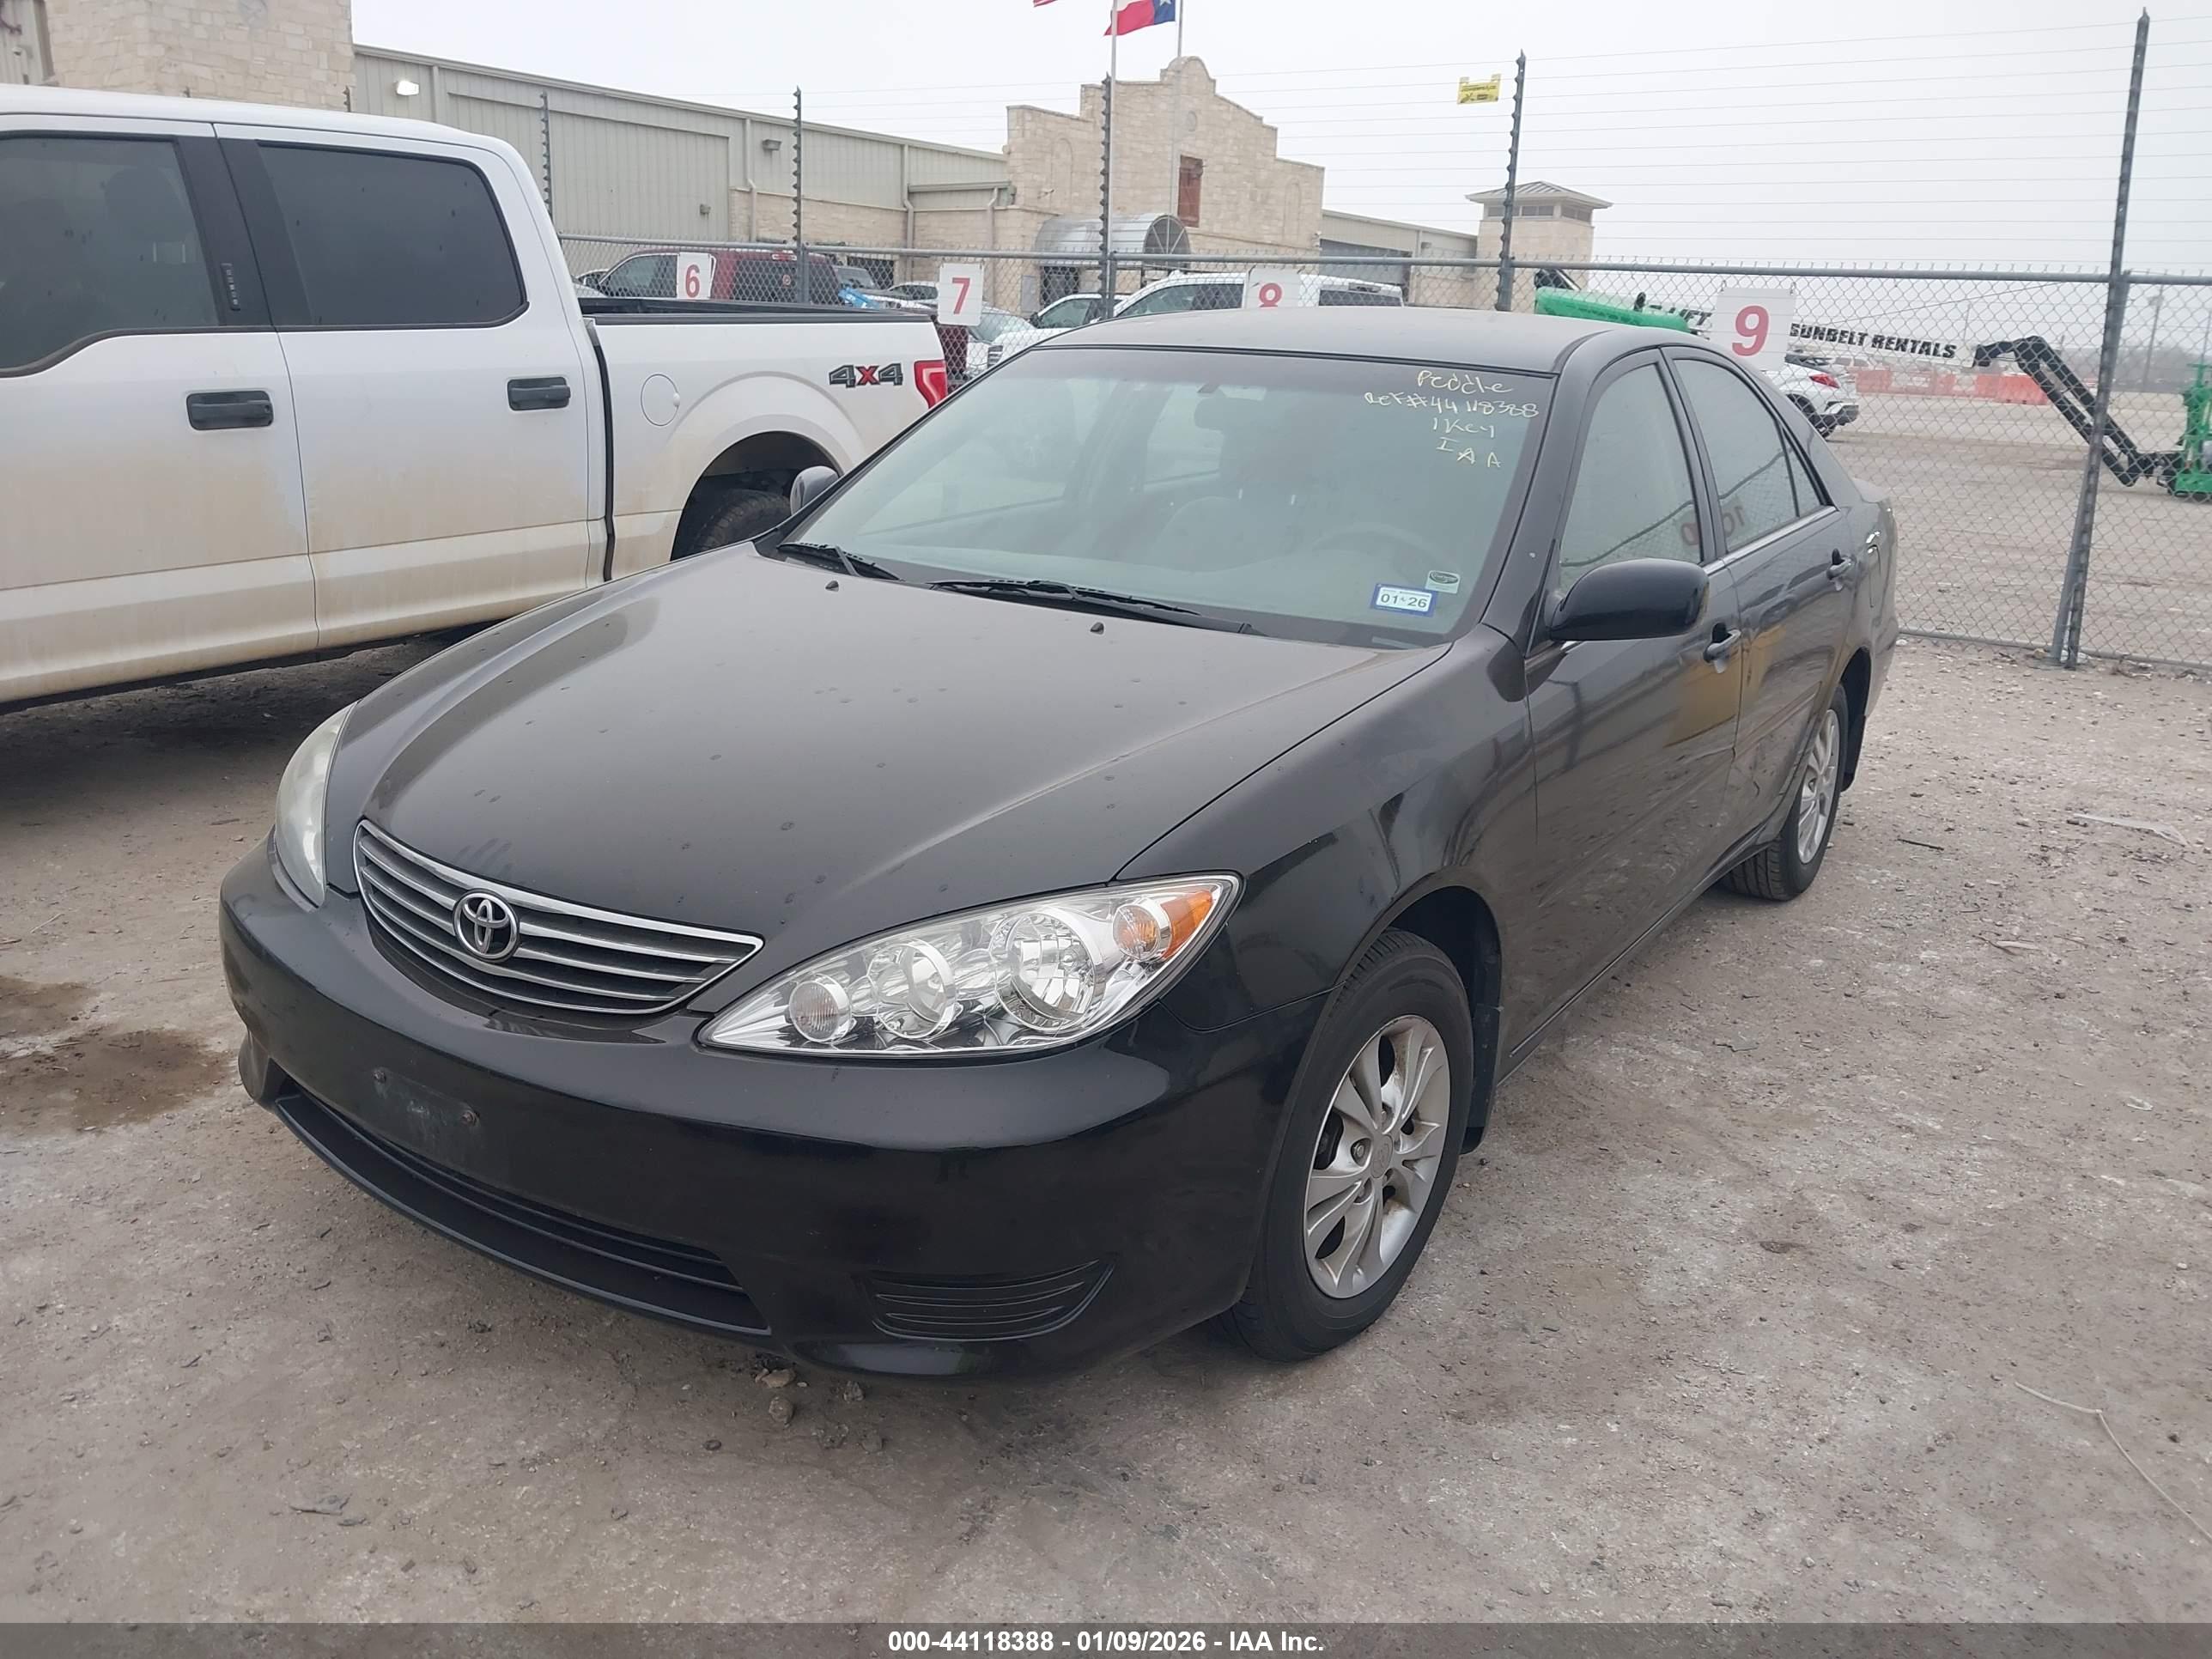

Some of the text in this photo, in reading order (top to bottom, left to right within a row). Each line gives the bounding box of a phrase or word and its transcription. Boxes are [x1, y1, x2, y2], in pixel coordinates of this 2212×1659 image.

[685, 264, 700, 298] 6
[951, 277, 971, 314] 7
[1731, 305, 1770, 357] 9
[1789, 322, 1957, 359] SUNBELT RENTALS
[829, 362, 903, 388] 4x4
[1380, 593, 1428, 608] 01 26
